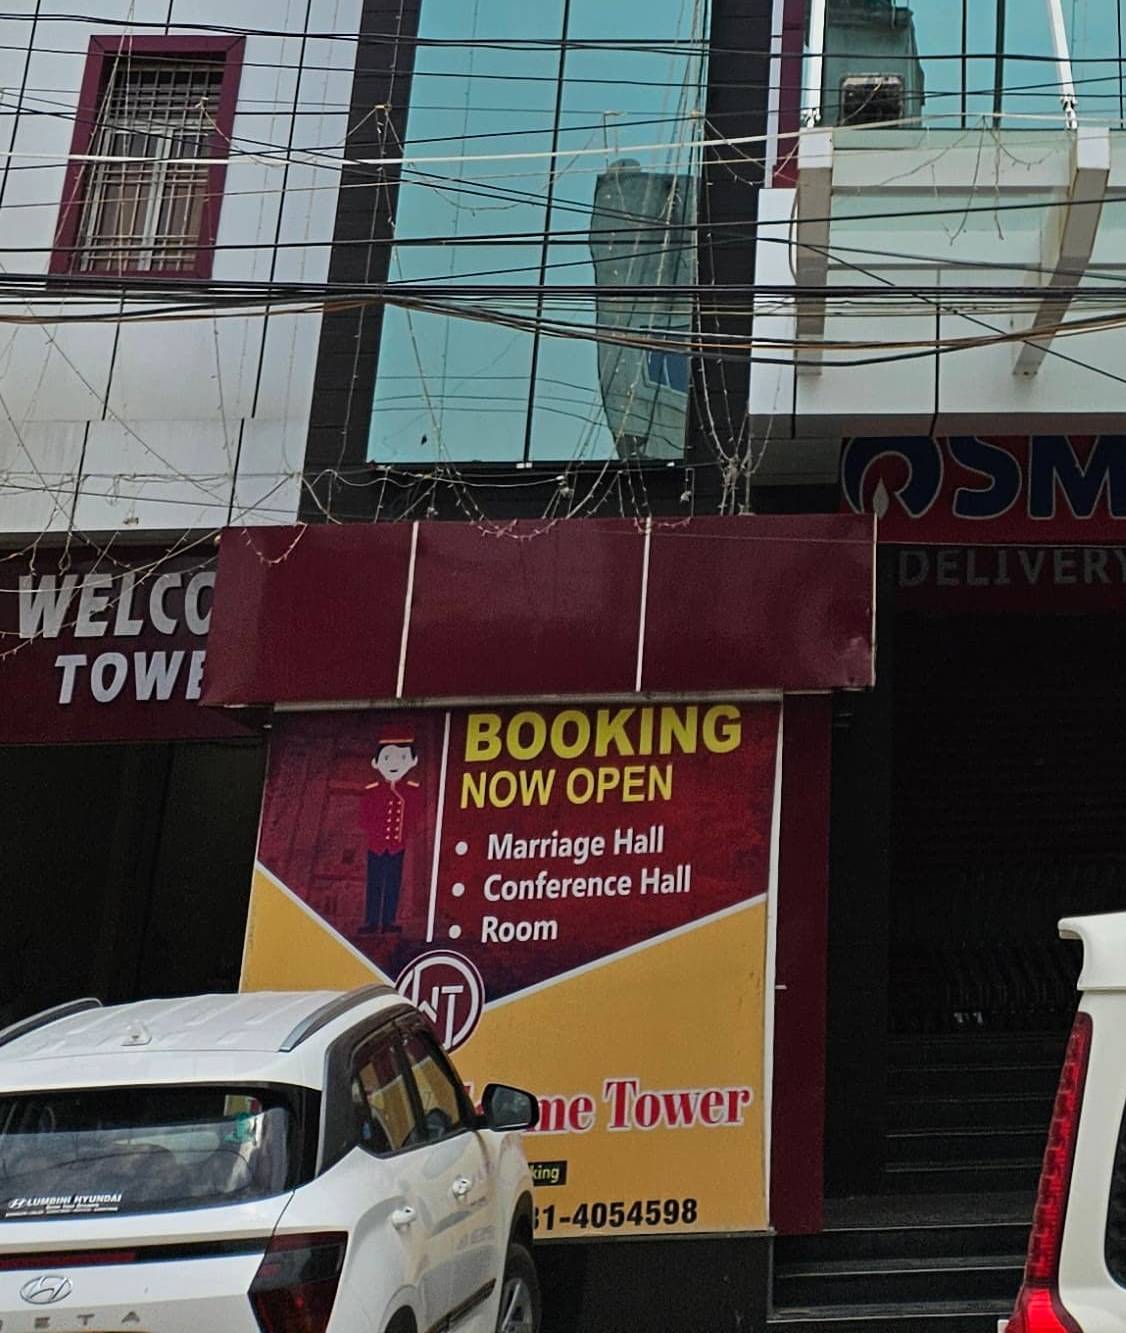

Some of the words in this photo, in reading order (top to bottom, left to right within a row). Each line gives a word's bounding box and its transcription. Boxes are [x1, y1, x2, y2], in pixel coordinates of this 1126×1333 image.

[464, 704, 743, 763] BOOKING
[460, 768, 556, 809] NOW
[565, 764, 674, 805] OPEN
[487, 829, 606, 865] Marriage
[613, 824, 665, 856] Hall
[483, 870, 632, 903] Conference
[640, 863, 692, 895] Hall
[480, 916, 559, 944] Room
[604, 1080, 751, 1131] Tower
[73, 1193, 122, 1204] HYUNDAI
[0, 1310, 141, 1331] ETA
